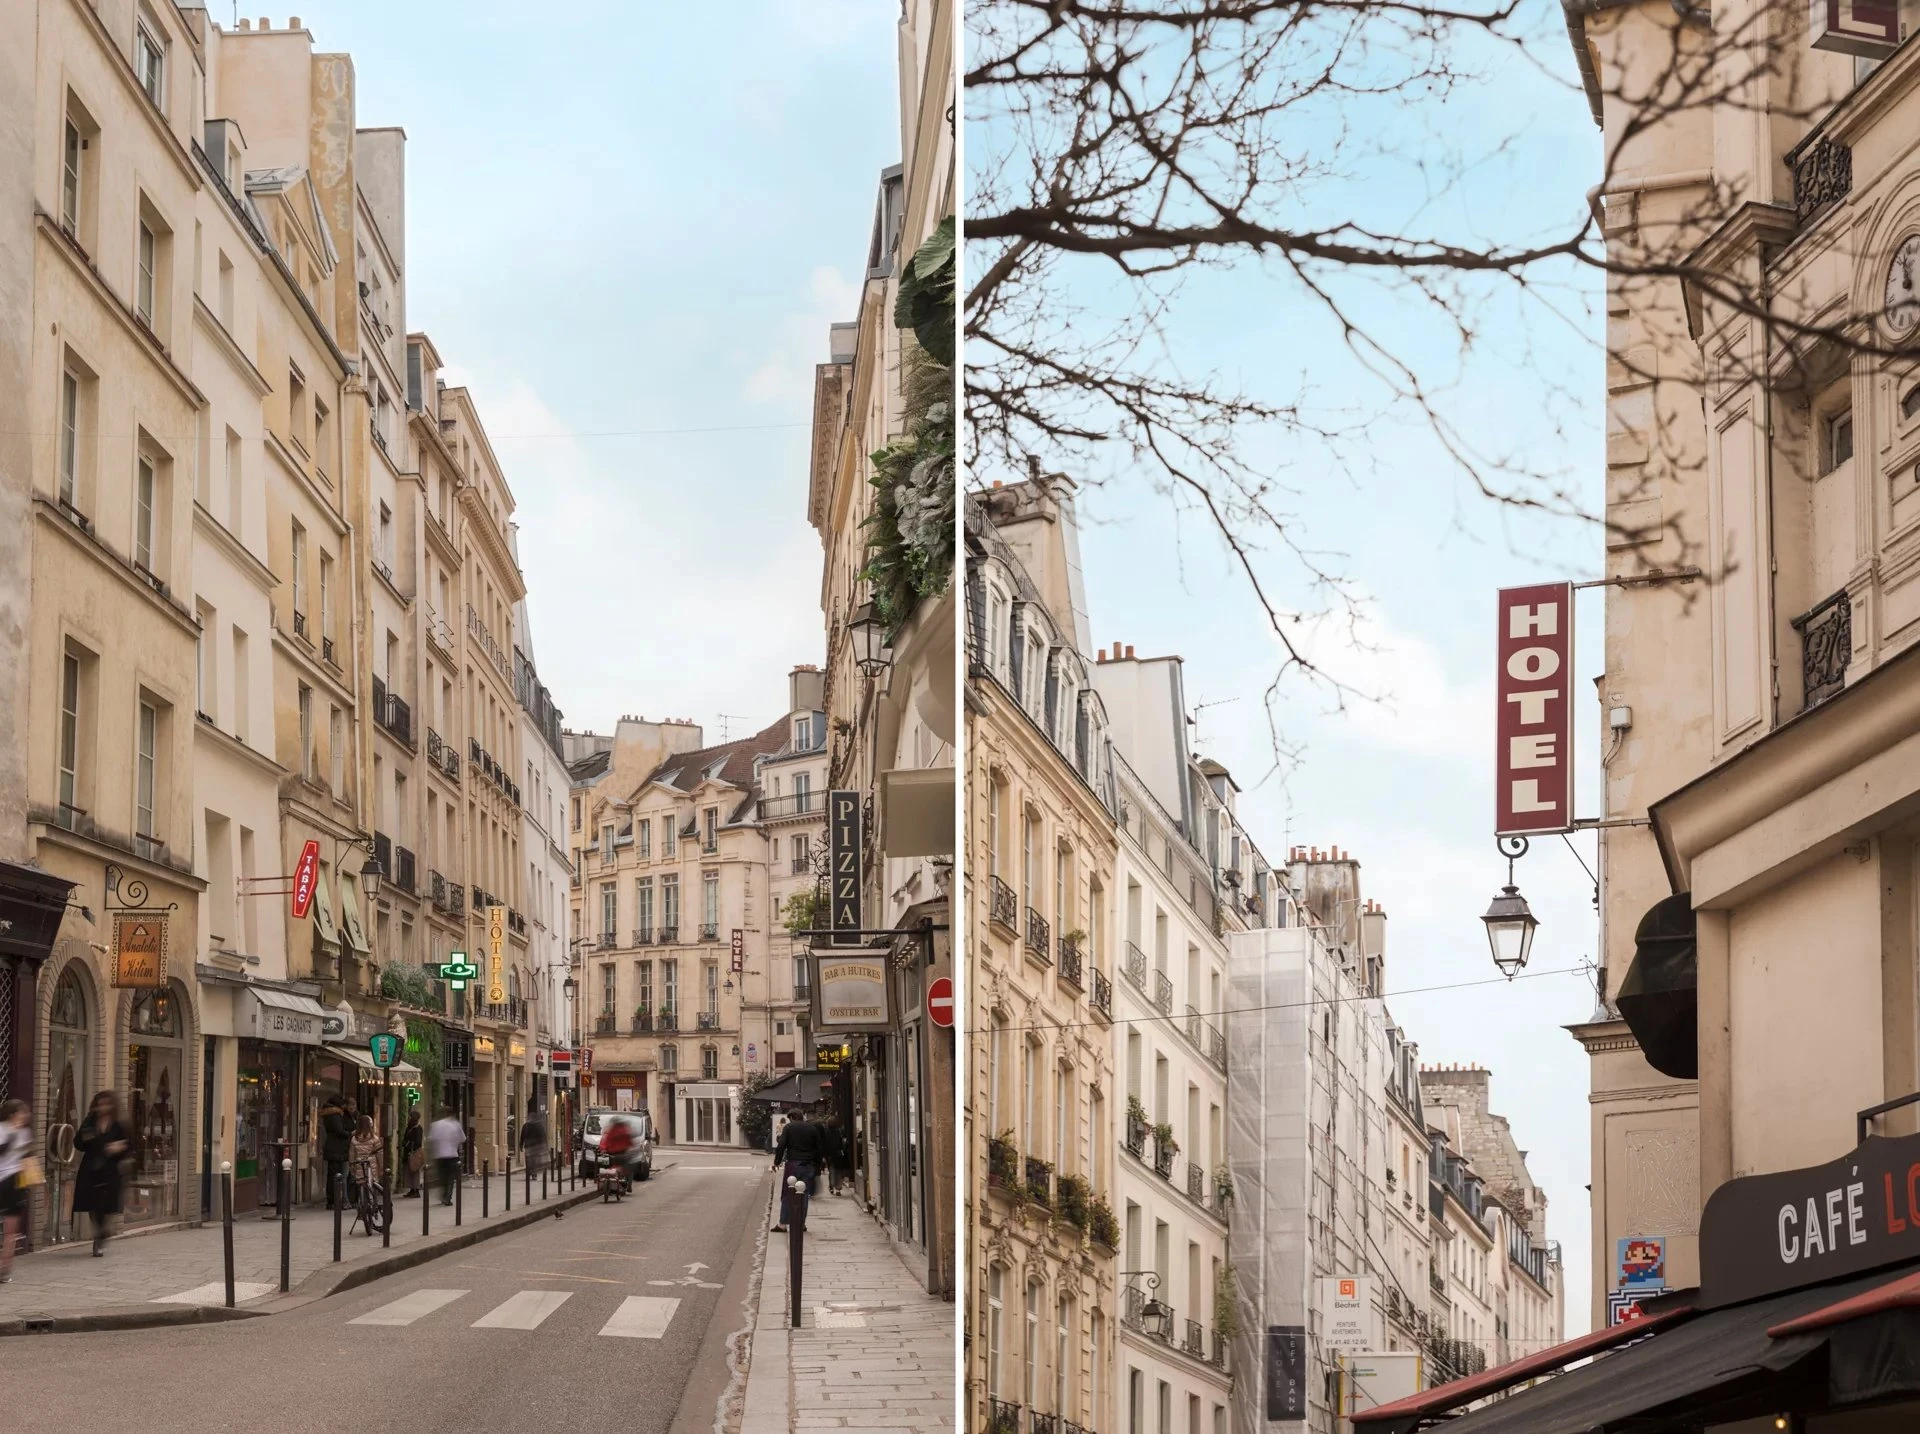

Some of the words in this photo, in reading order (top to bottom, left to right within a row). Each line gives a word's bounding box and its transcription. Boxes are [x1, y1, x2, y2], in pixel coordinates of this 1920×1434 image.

[1506, 602, 1560, 814] HOTEL
[297, 855, 313, 903] TABAC
[838, 800, 857, 925] PIZZA
[490, 908, 503, 985] HÔTEL
[733, 931, 742, 970] HOTEL
[123, 959, 153, 978] Kilim
[824, 967, 839, 981] BAR
[847, 966, 881, 980] HUITRES
[273, 1015, 284, 1031] LES
[286, 1016, 312, 1034] GAGNANTS
[829, 1008, 860, 1017] OYSTER
[863, 1008, 879, 1017] BAR
[612, 1075, 634, 1084] NICOLAS
[1778, 1165, 1867, 1264] CAFÉ
